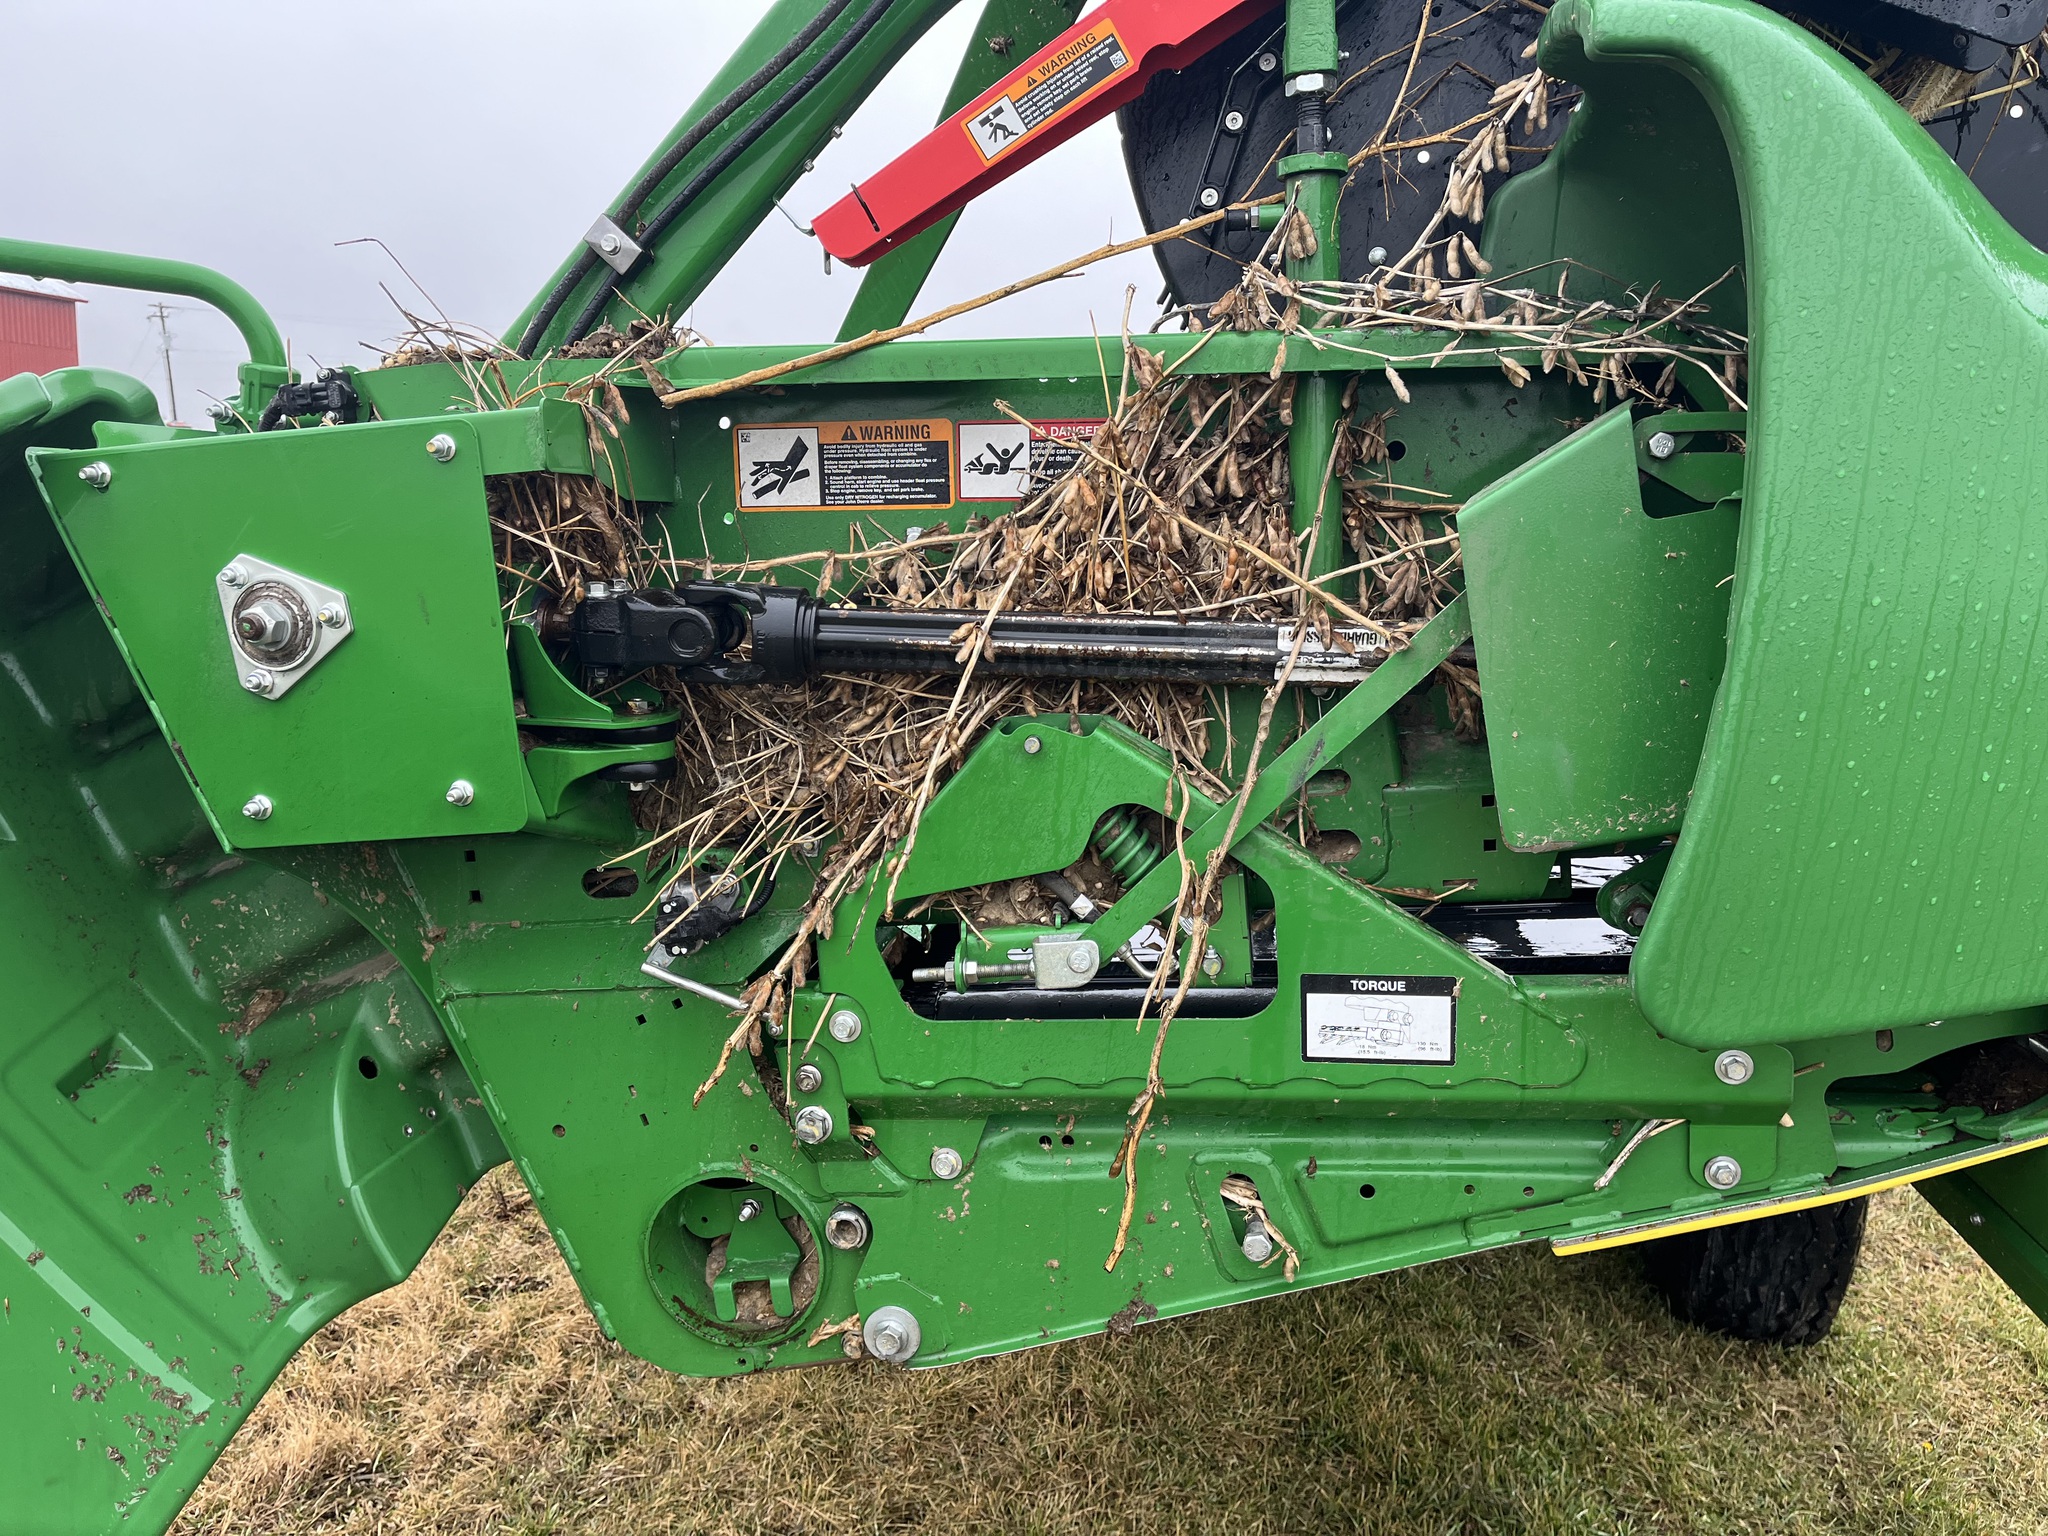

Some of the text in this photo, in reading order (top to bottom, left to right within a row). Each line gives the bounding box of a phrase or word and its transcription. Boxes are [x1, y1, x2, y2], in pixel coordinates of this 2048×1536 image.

[1015, 96, 1028, 108] Avoid
[1028, 83, 1047, 98] crushing
[1046, 72, 1063, 85] injuries
[1063, 64, 1074, 74] from
[1090, 42, 1104, 55] raised
[1038, 33, 1096, 77] WARNING
[1018, 100, 1032, 112] Before
[1032, 88, 1050, 102] working
[1062, 71, 1074, 82] under
[1074, 60, 1089, 73] raised
[1098, 48, 1110, 56] stop
[1024, 114, 1033, 123] and
[1040, 100, 1054, 112] safety
[1054, 94, 1064, 102] stop
[1070, 82, 1081, 91] each
[860, 424, 930, 440] WARNING
[1350, 980, 1406, 992] TORQUE
